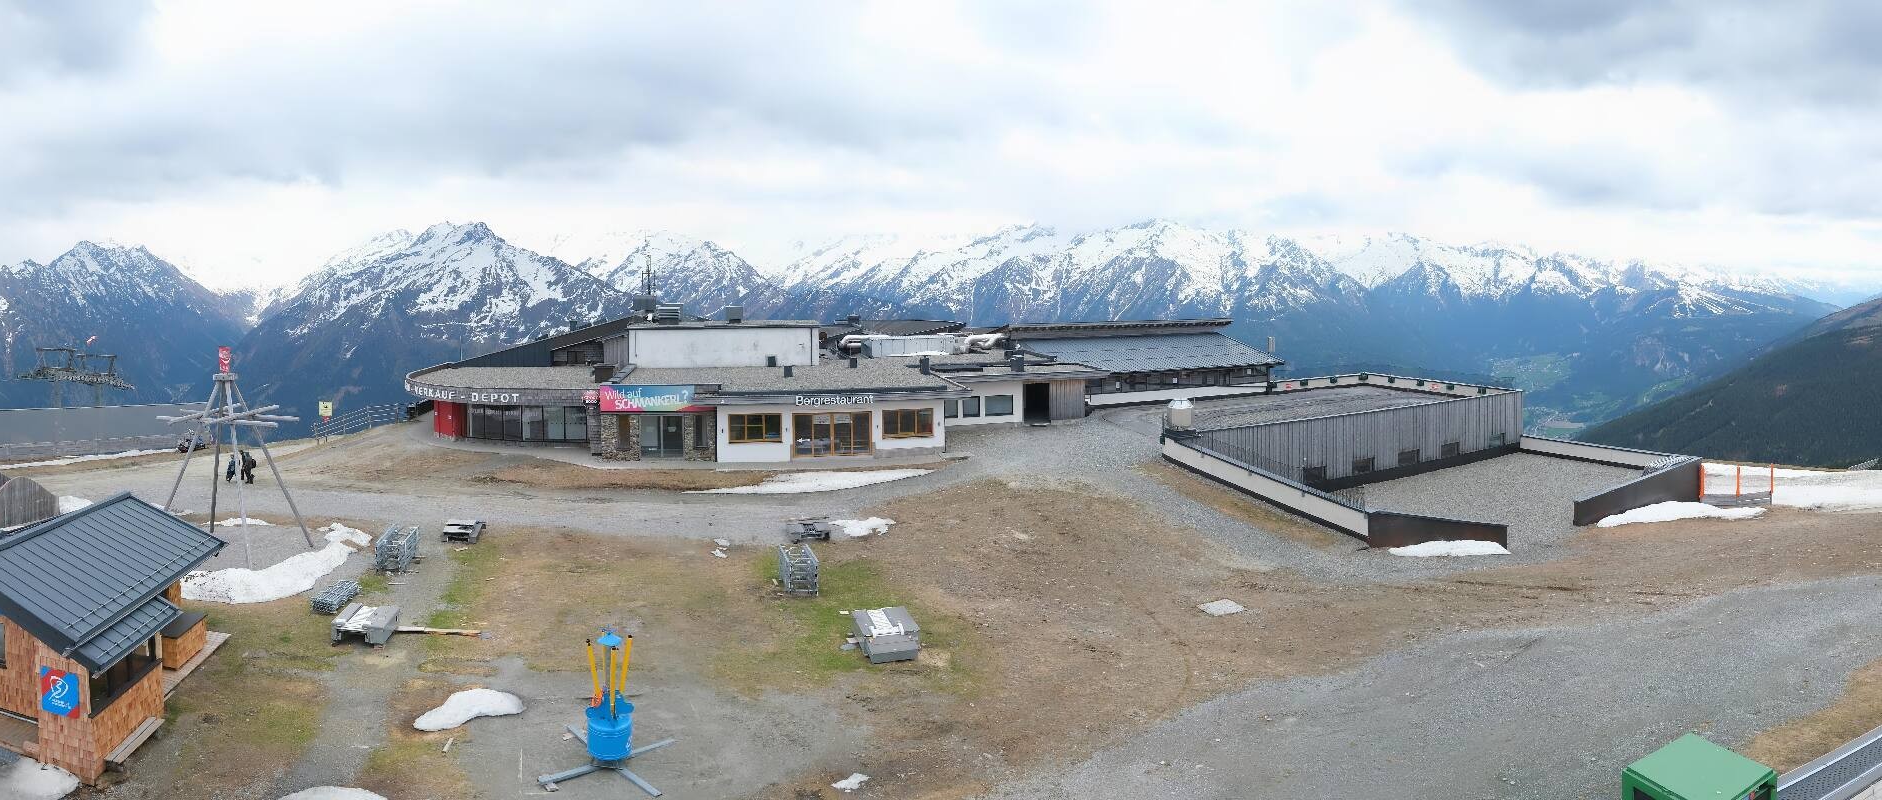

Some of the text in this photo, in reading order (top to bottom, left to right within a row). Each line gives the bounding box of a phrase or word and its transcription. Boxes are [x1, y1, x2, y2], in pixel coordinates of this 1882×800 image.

[414, 385, 456, 400] VERKAUF
[471, 392, 520, 403] DEPOT
[604, 387, 643, 401] Wild auf
[615, 389, 689, 410] SCHMANKERL?
[796, 395, 874, 407] Bergrestaurant
